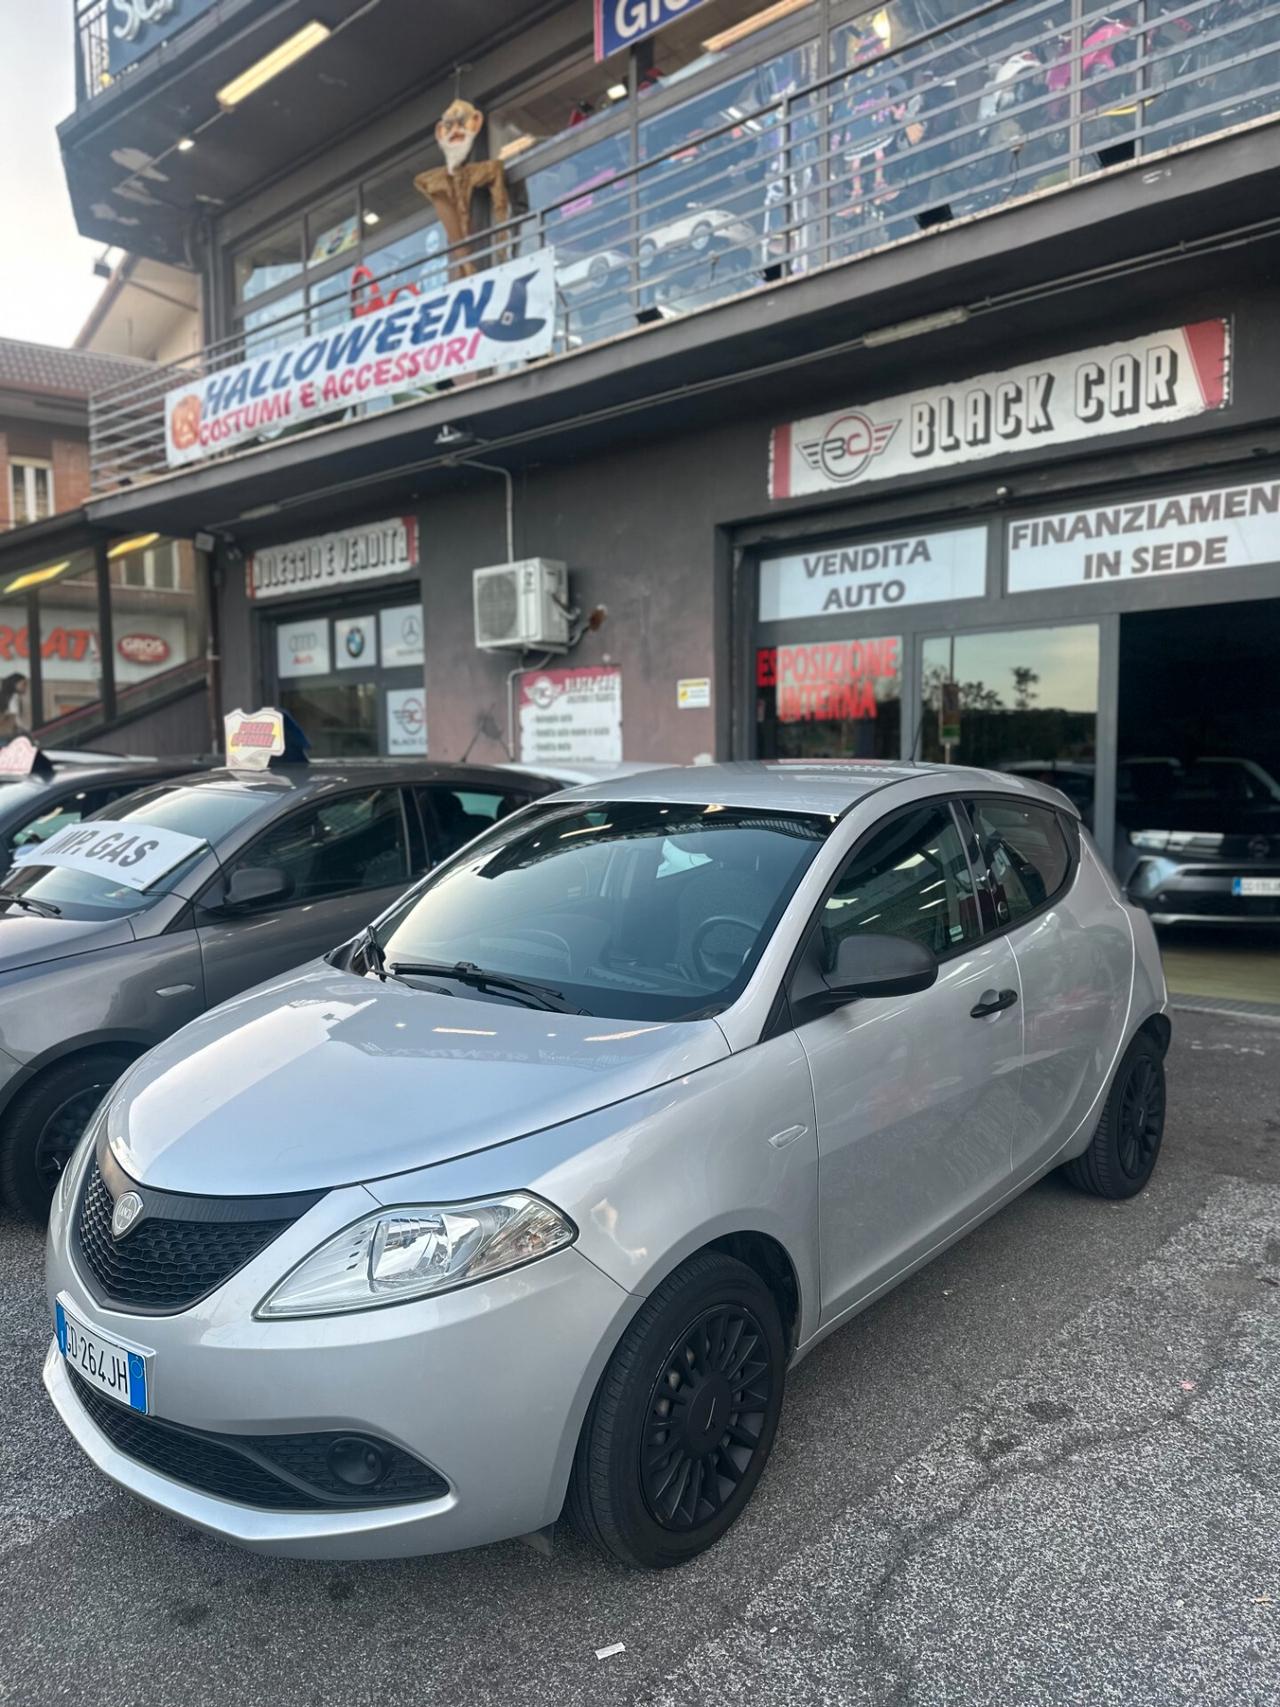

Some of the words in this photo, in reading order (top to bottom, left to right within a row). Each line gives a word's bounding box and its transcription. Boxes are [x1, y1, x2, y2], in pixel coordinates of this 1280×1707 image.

[203, 280, 495, 418] HALLOWEEN
[199, 390, 292, 446] COSTUMI
[299, 382, 316, 409] E
[322, 333, 482, 401] ACCESSORI
[911, 373, 1054, 458] BLACK
[1074, 345, 1179, 423] CAR
[1011, 484, 1280, 550] FINANZIAMEN
[341, 527, 408, 574] VENDITA
[803, 539, 931, 579] VENDITA
[1083, 550, 1122, 580] IN
[1131, 536, 1228, 575] SEDE
[822, 580, 905, 611] AUTO
[121, 637, 165, 654] GROS
[757, 637, 898, 687] ESPOSIZIONE
[777, 681, 878, 723] INTERNA
[85, 832, 159, 868] GAS
[80, 1336, 128, 1394] 264JH
